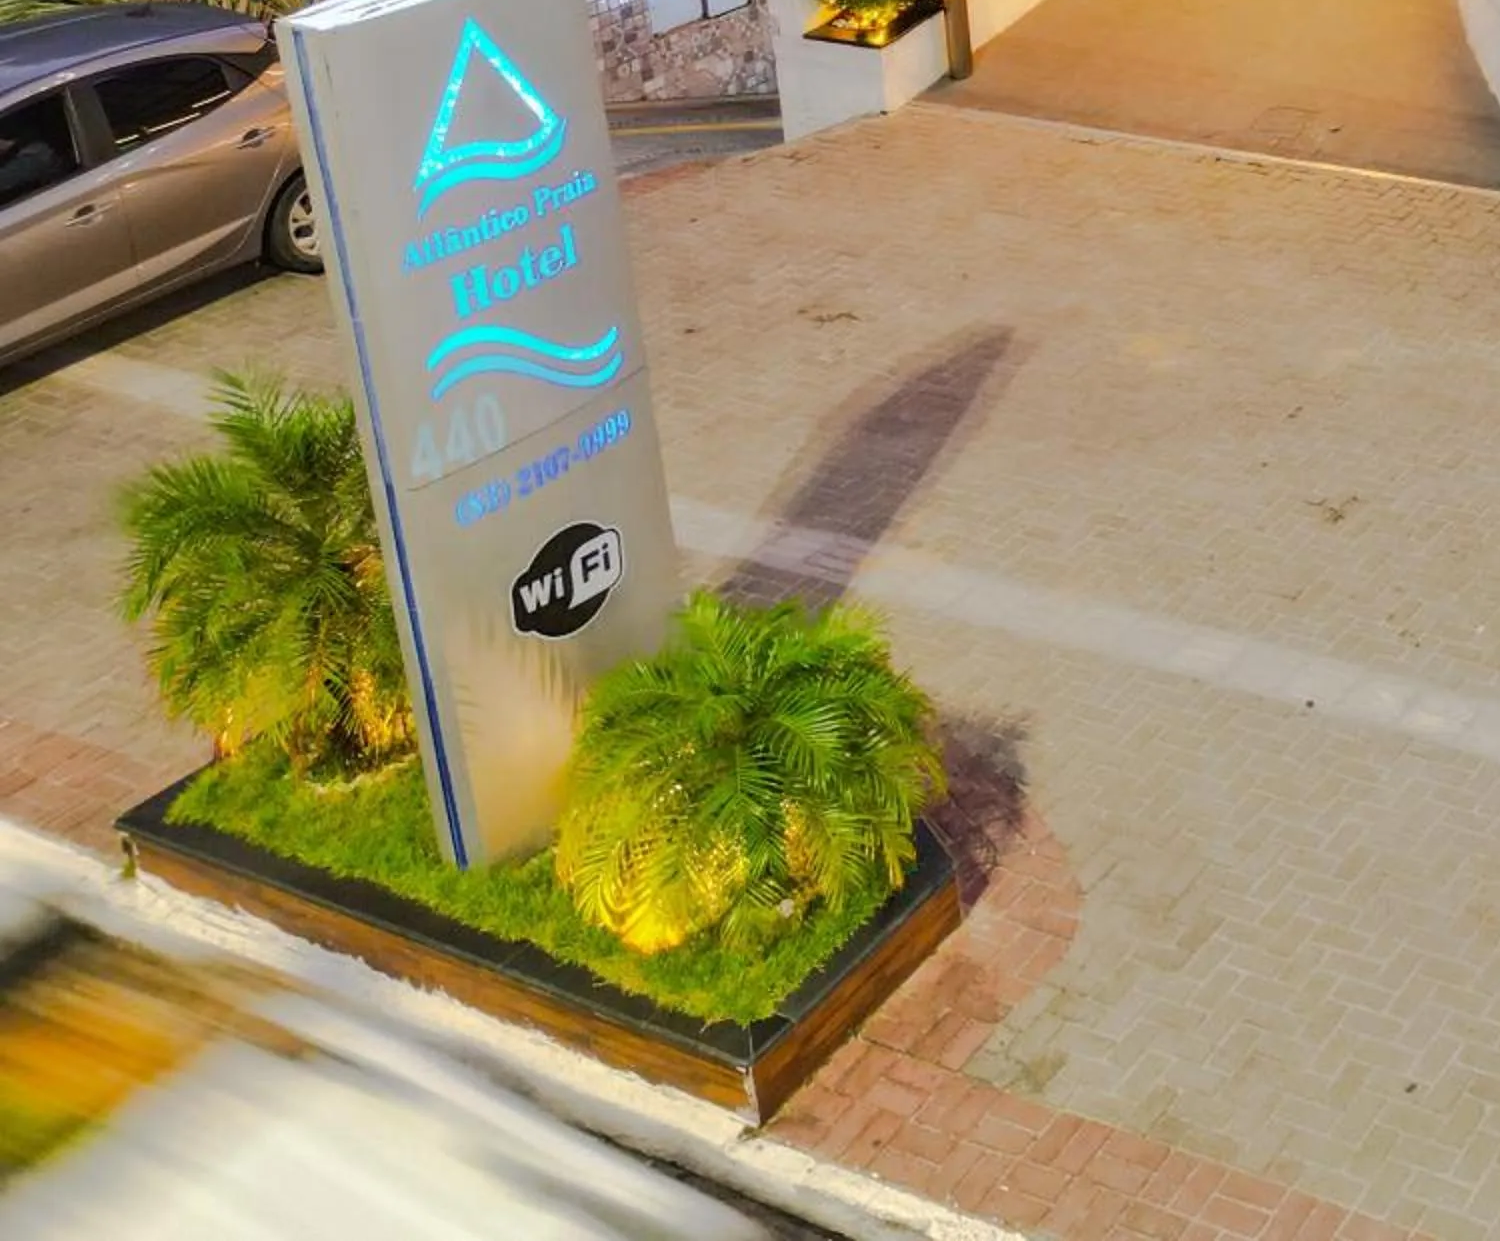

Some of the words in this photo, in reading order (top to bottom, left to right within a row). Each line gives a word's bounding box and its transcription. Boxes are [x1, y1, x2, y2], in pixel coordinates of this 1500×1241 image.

[533, 170, 596, 216] Praia
[451, 223, 577, 318] Hotel
[411, 392, 506, 477] 440
